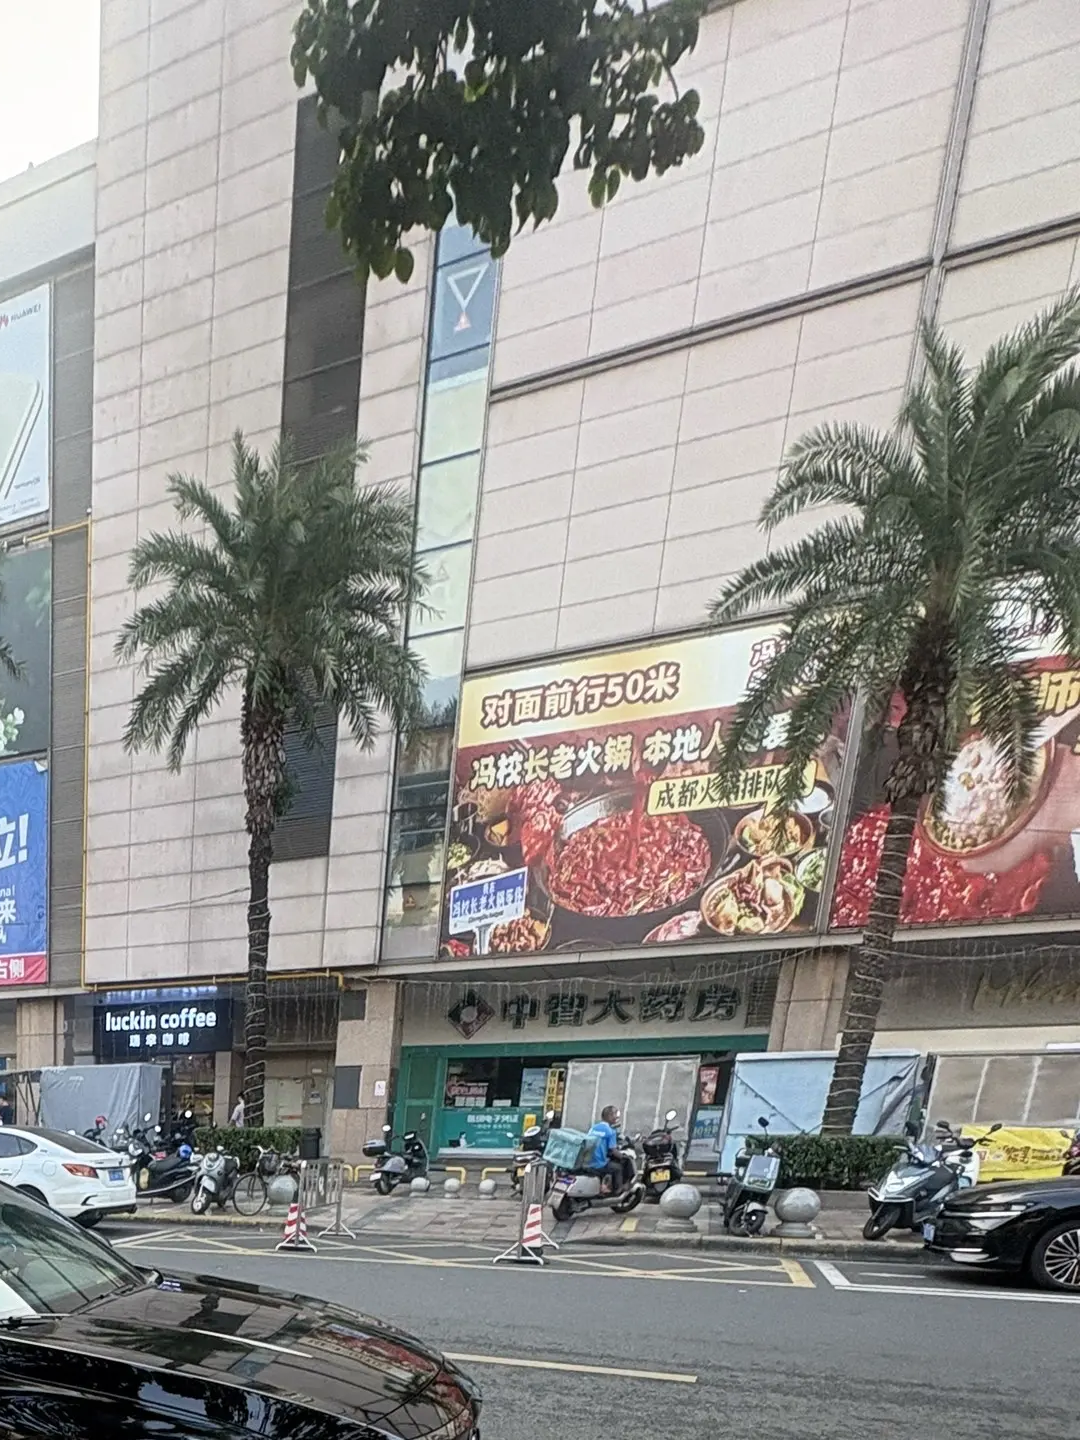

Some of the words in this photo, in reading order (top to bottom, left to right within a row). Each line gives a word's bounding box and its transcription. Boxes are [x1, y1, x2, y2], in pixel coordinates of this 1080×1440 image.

[10, 304, 41, 323] HUAWEI
[481, 661, 681, 728] 对面前行50米
[469, 734, 634, 792] 冯校长老火锅
[105, 1010, 157, 1032] luckin
[160, 1007, 217, 1029] coffee
[503, 984, 742, 1030] 中智大药房
